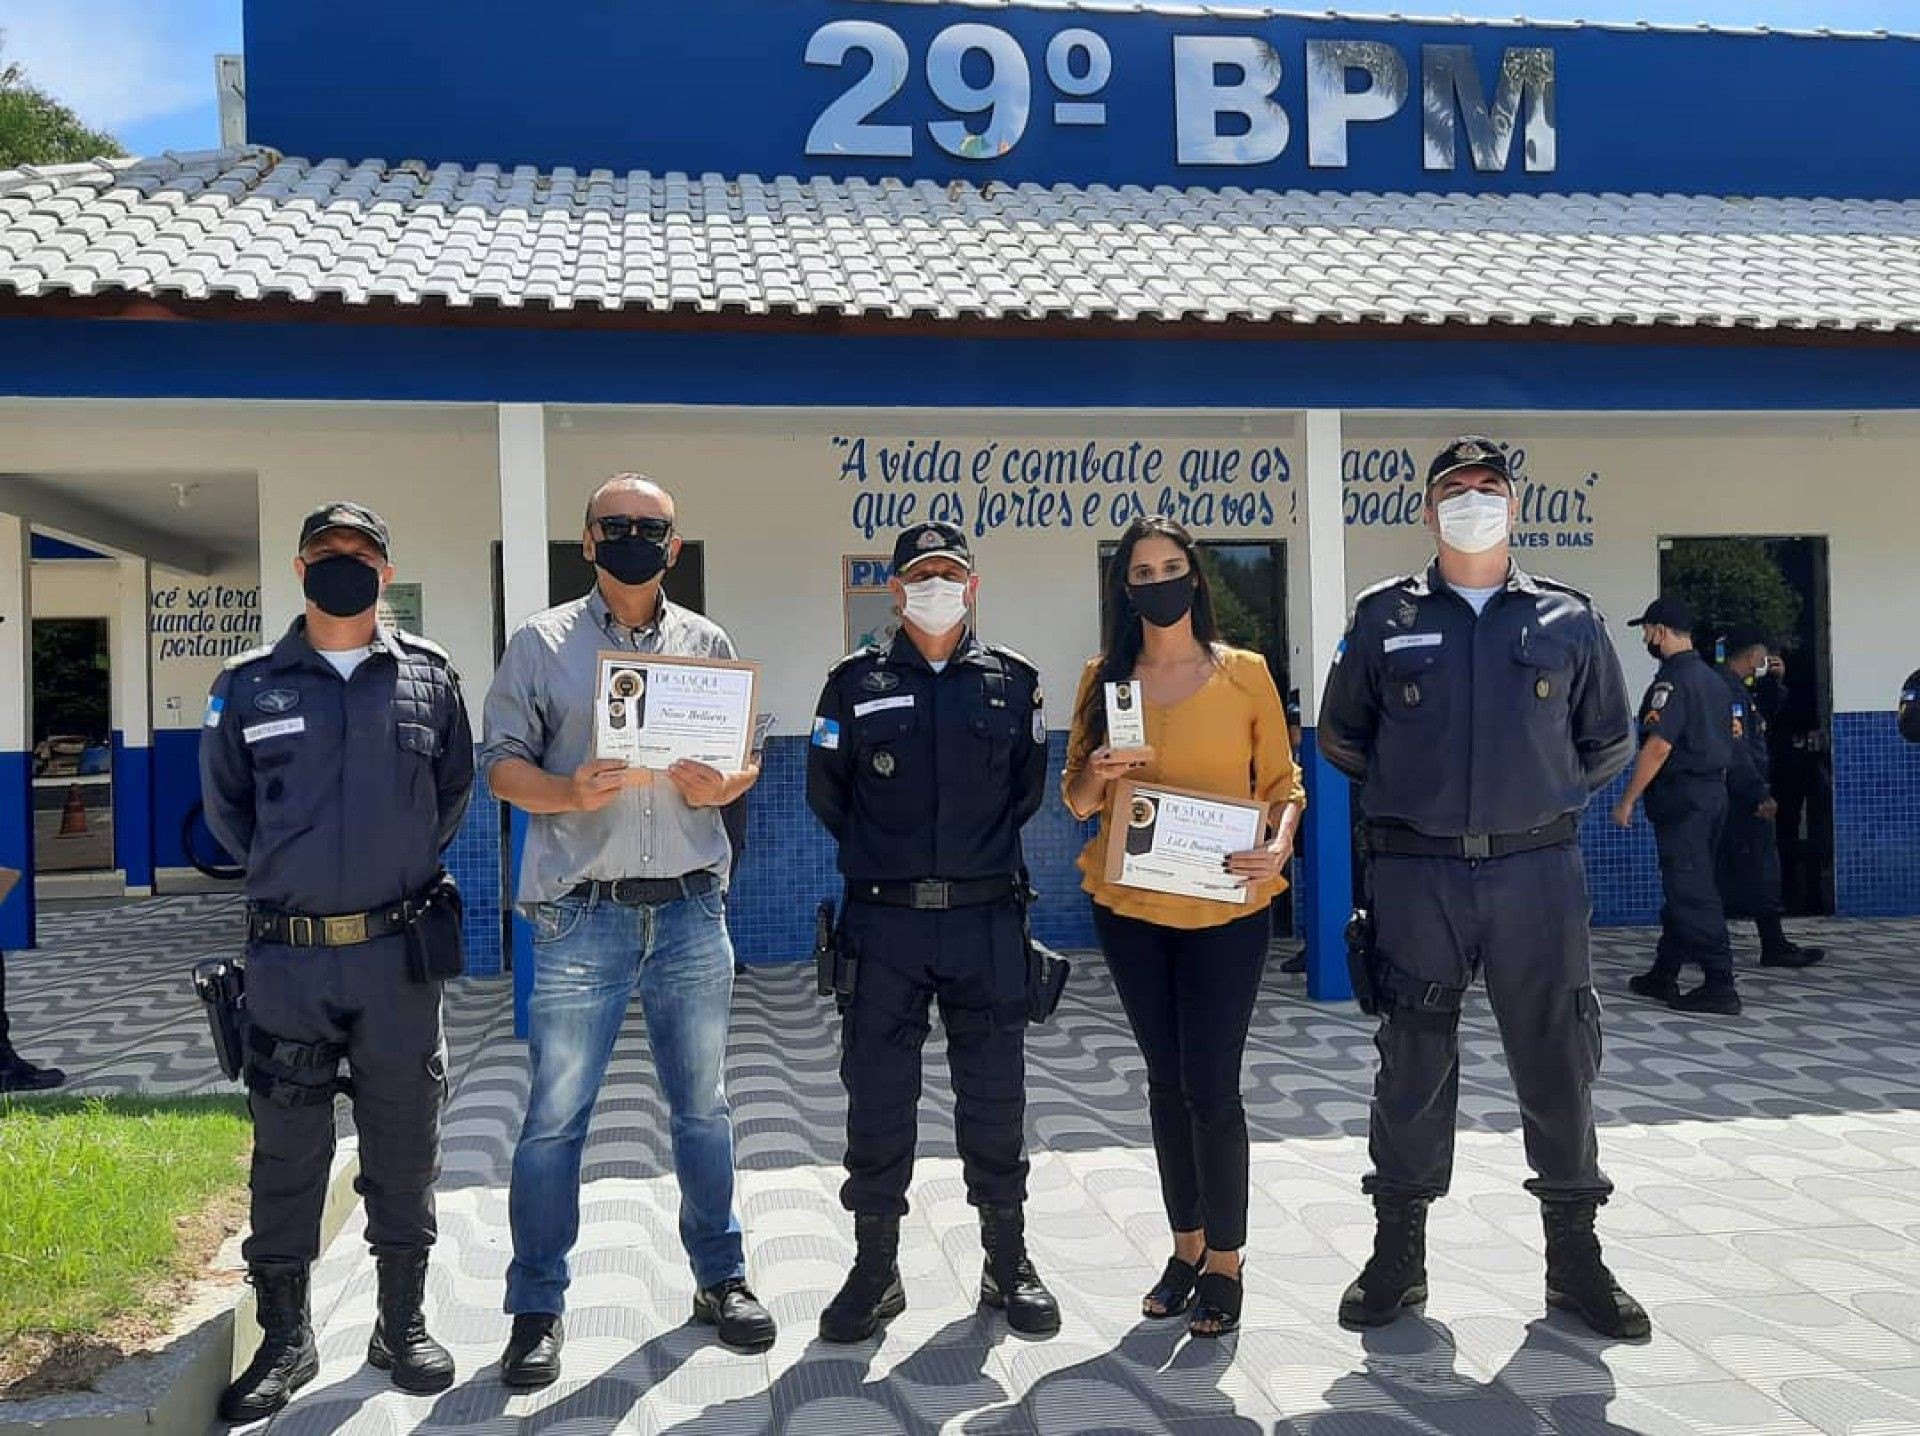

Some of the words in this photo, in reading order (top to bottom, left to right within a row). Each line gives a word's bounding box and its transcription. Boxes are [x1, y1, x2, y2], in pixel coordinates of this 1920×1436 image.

[804, 20, 1112, 159] 29º
[1174, 35, 1557, 172] BPM
[877, 440, 961, 483] vida
[971, 441, 999, 484] é
[1001, 440, 1162, 484] combate
[1179, 448, 1238, 490] que
[1250, 446, 1290, 482] os
[1341, 447, 1416, 482] acos
[852, 491, 916, 540] que
[929, 491, 965, 528] os
[974, 486, 1073, 538] fortes
[1082, 491, 1101, 528] e
[1110, 491, 1147, 526] os
[1158, 486, 1274, 527] bravos
[1556, 532, 1594, 547] DIAS
[151, 609, 216, 633] uando
